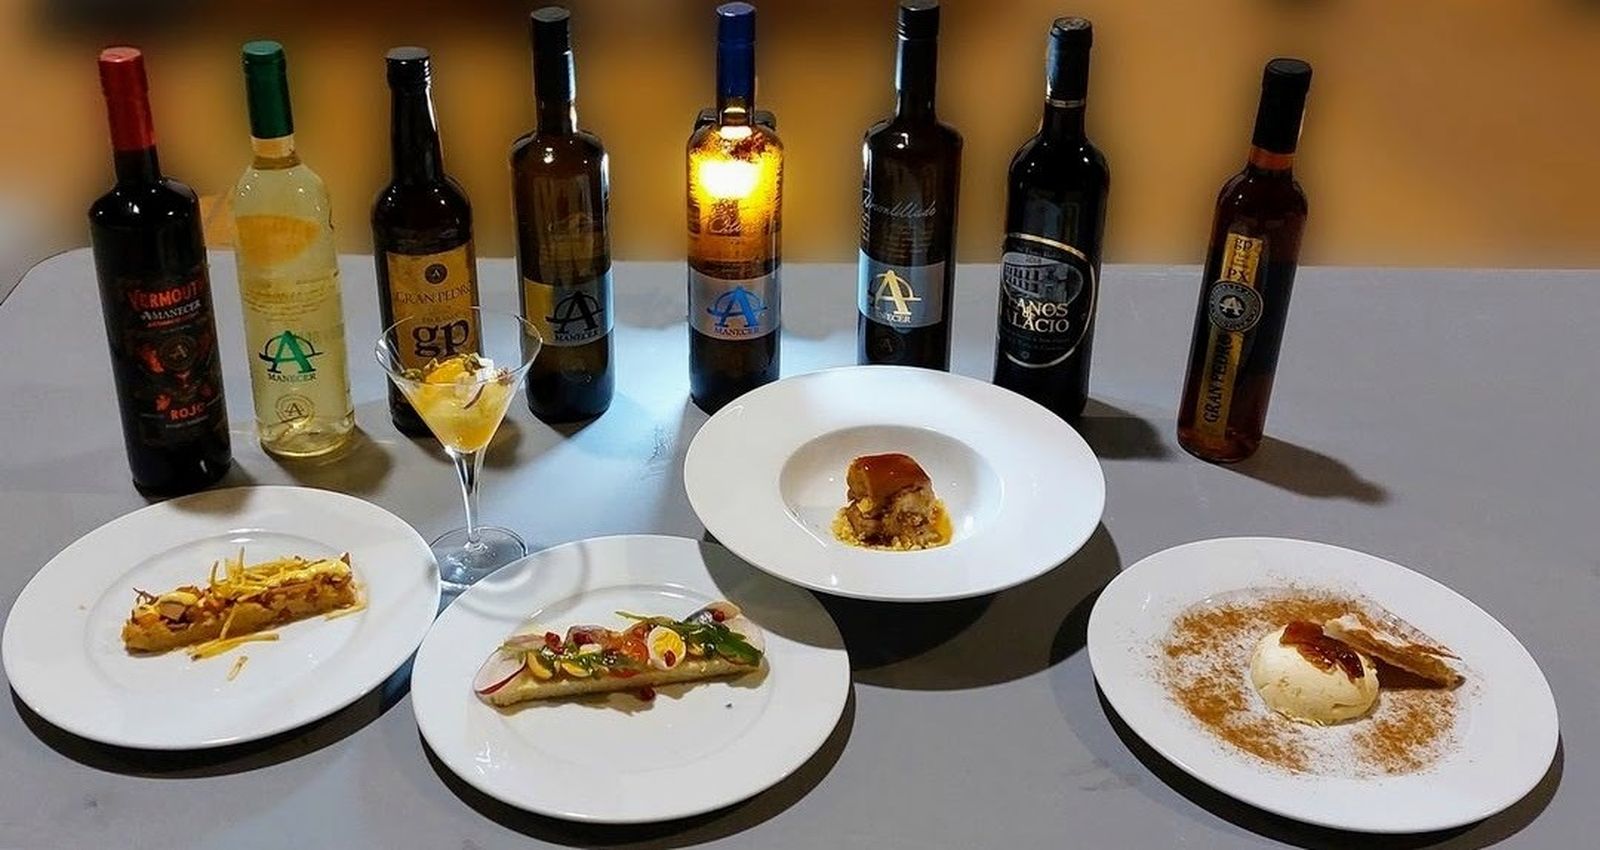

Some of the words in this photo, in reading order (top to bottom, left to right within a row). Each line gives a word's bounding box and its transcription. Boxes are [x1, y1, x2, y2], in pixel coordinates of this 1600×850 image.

[412, 319, 469, 358] gp
[268, 373, 317, 382] MANECER
[170, 402, 207, 420] ROJO
[1203, 384, 1222, 424] GRAN
